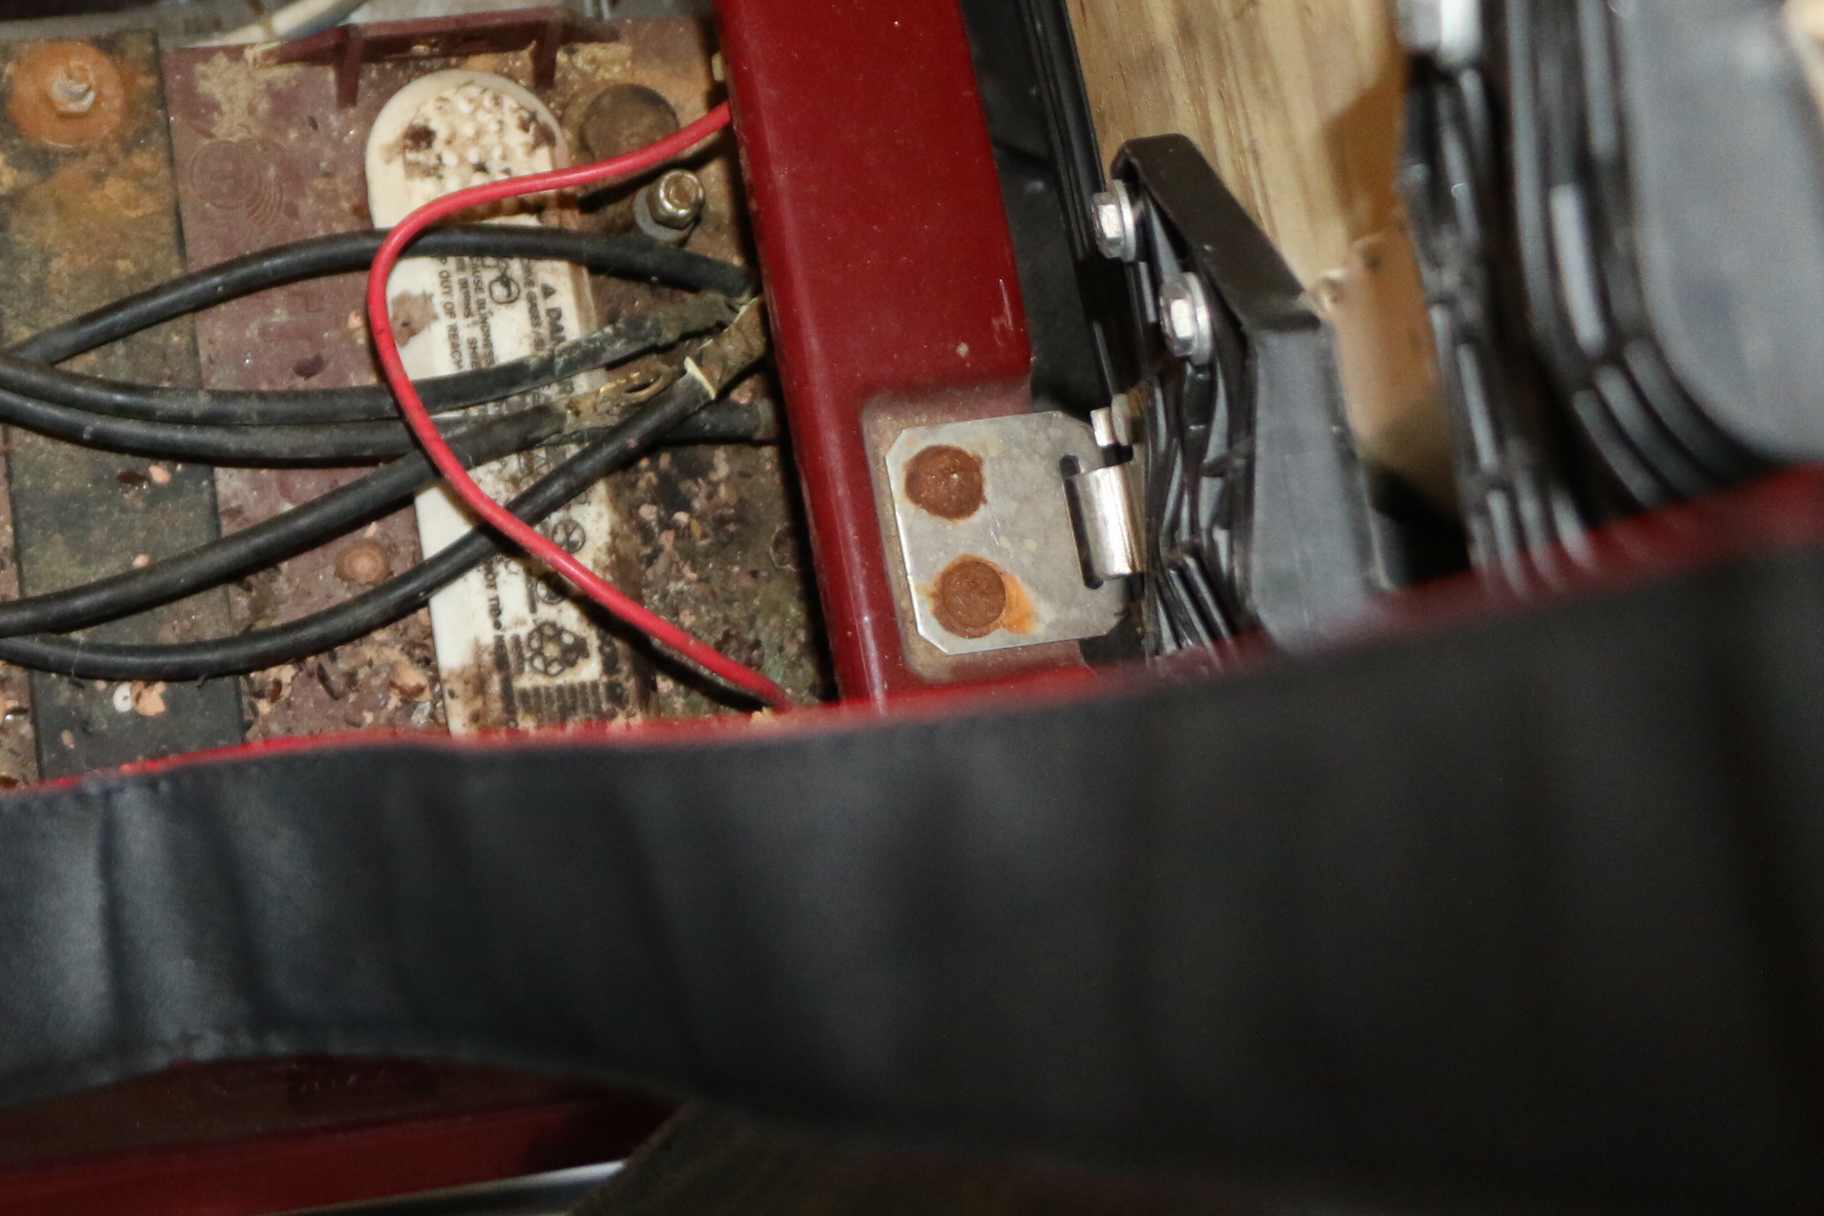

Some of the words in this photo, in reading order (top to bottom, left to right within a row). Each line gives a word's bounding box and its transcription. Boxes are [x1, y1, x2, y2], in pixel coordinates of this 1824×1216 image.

[438, 270, 453, 297] OUT
[444, 302, 456, 319] OF
[447, 323, 464, 370] REACH
